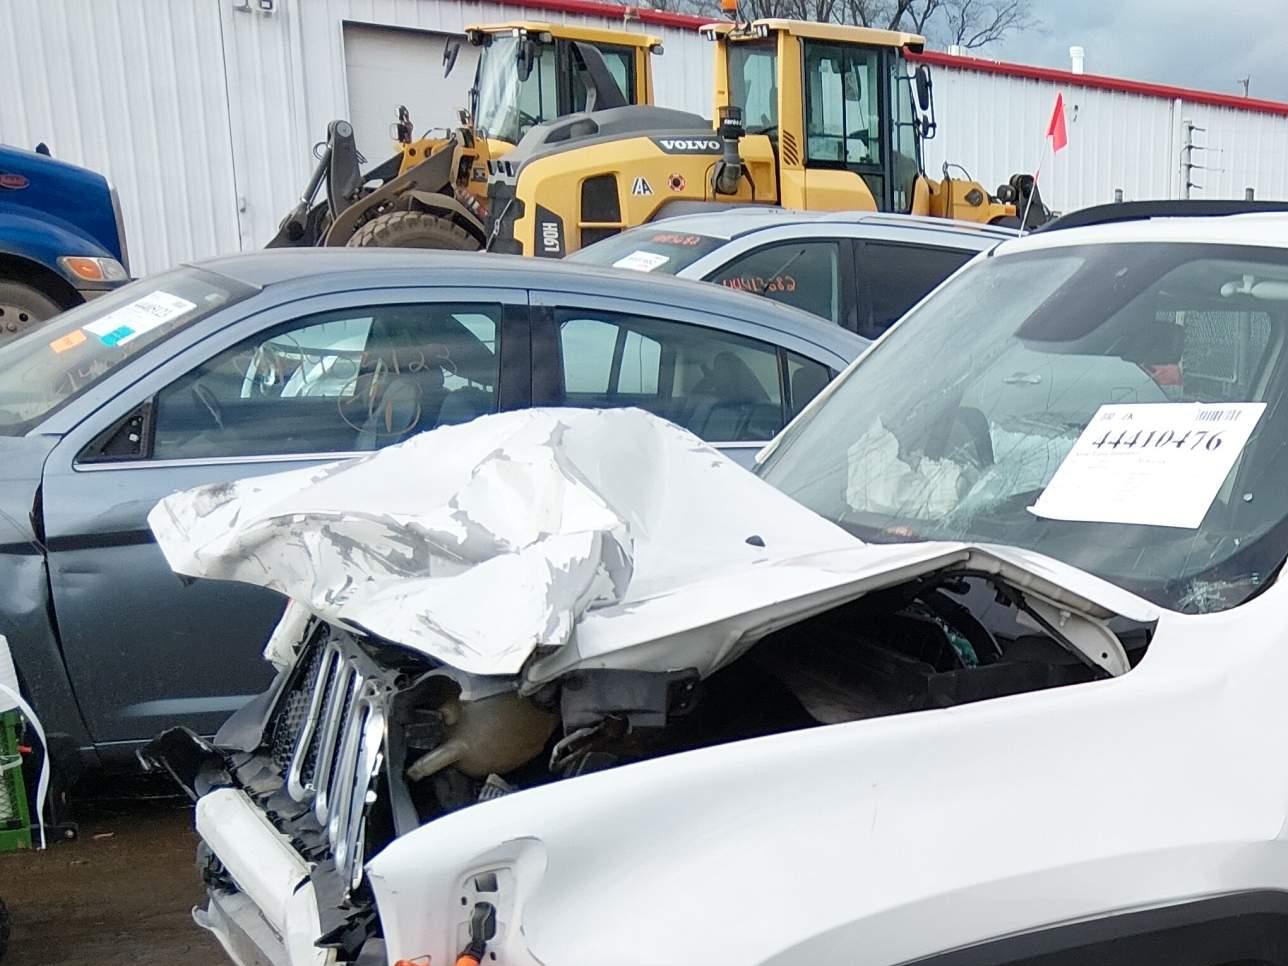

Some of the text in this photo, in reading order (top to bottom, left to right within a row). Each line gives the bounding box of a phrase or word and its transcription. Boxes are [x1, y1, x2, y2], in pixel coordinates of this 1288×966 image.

[659, 140, 721, 151] VOLVO
[542, 222, 560, 252] L90H
[1092, 429, 1227, 452] 44410476
